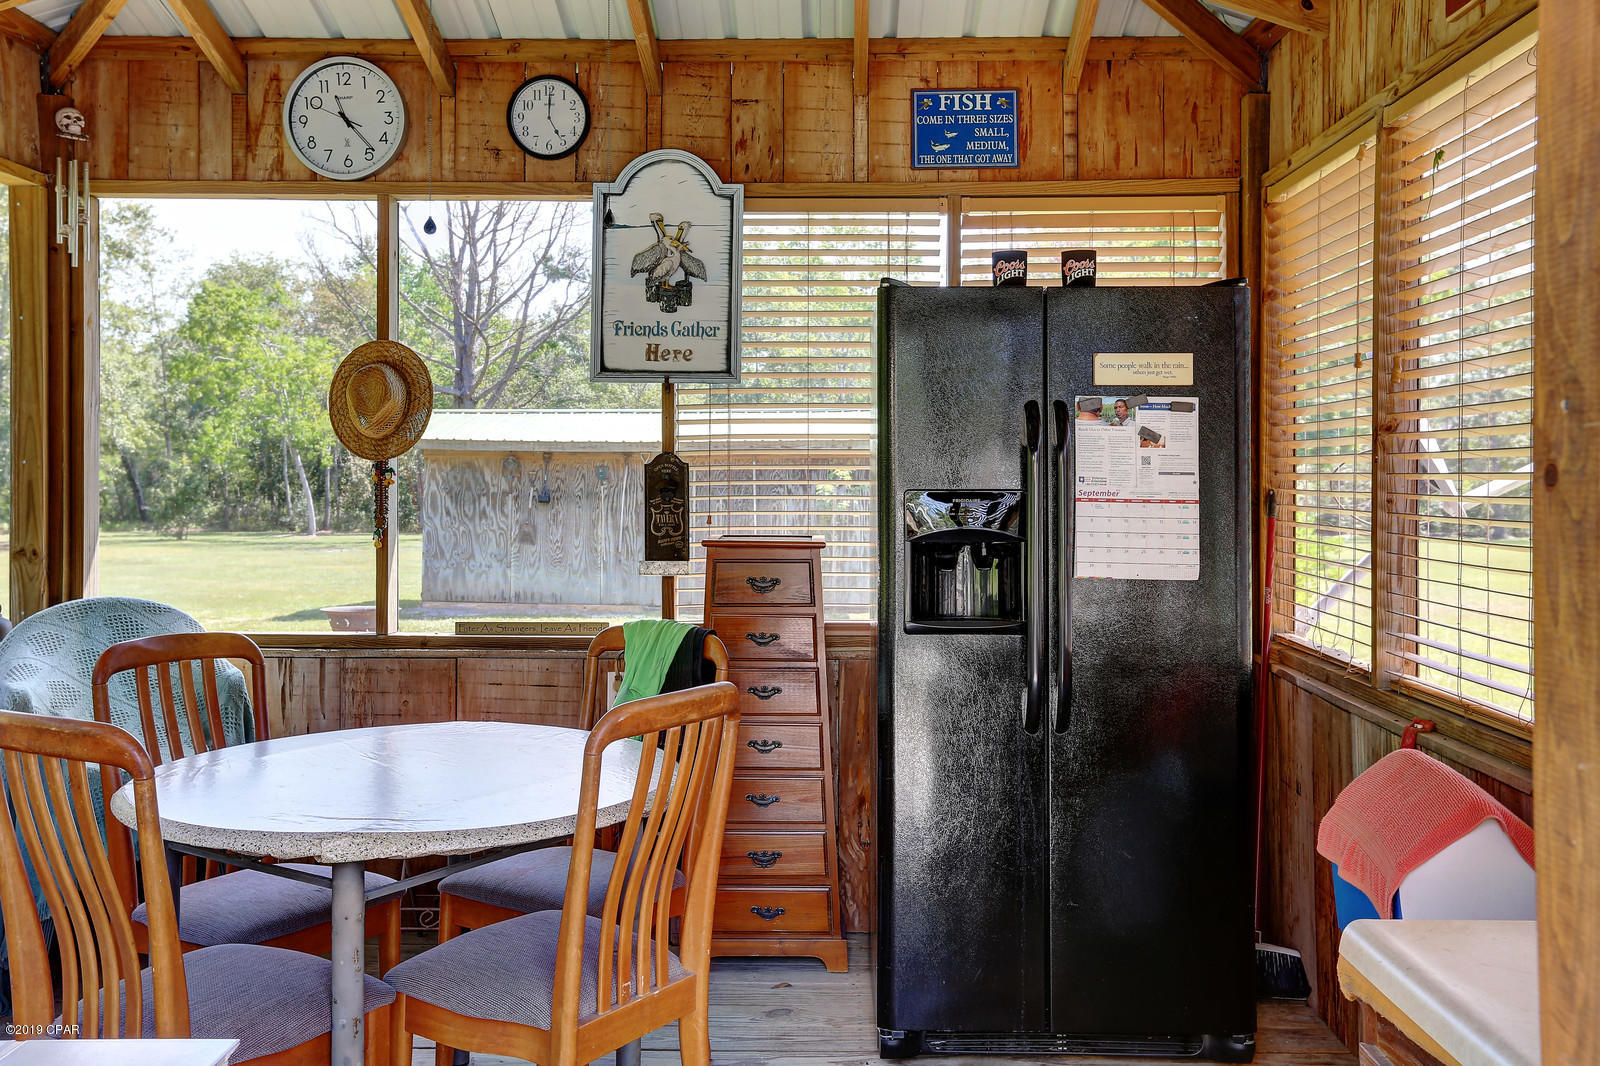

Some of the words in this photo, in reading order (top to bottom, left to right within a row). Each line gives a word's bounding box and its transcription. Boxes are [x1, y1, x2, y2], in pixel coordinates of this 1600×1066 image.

[336, 72, 352, 86] 12
[319, 80, 329, 93] 11
[544, 85, 554, 96] 12
[376, 90, 385, 103] 2
[533, 90, 541, 100] 11
[305, 96, 322, 110] 10
[523, 100, 533, 110] 10
[570, 100, 576, 110] 2
[939, 94, 992, 110] FISH
[299, 115, 308, 128] 9
[384, 112, 394, 124] 3
[518, 112, 524, 123] 9
[574, 112, 580, 123] 3
[917, 116, 943, 124] COME
[945, 116, 955, 124] IN
[957, 115, 987, 124] THREE
[989, 114, 1014, 123] SIZES
[522, 126, 529, 137] 8
[570, 126, 577, 136] 4
[974, 128, 1010, 137] SMALL,
[308, 136, 316, 149] 8
[379, 132, 388, 144] 4
[533, 136, 539, 146] 7
[560, 135, 567, 146] 5
[546, 140, 552, 151] 6
[966, 141, 1009, 151] MEDIUM,
[324, 150, 333, 162] 7
[364, 148, 374, 161] 5
[920, 155, 935, 164] THE
[936, 155, 952, 164] ONE
[952, 155, 974, 163] THAT
[975, 154, 990, 163] GOT
[992, 154, 1013, 163] AWAY
[344, 154, 353, 168] 6
[994, 259, 1026, 277] Coors
[1064, 259, 1095, 275] Coors
[996, 270, 1024, 286] LIGHT
[1066, 269, 1095, 285] LIGHT
[613, 320, 668, 340] Friends
[670, 320, 720, 340] Gather
[645, 343, 693, 363] Here
[1117, 362, 1136, 371] people
[480, 624, 493, 632] As
[540, 624, 563, 633] Leave
[564, 624, 576, 632] As
